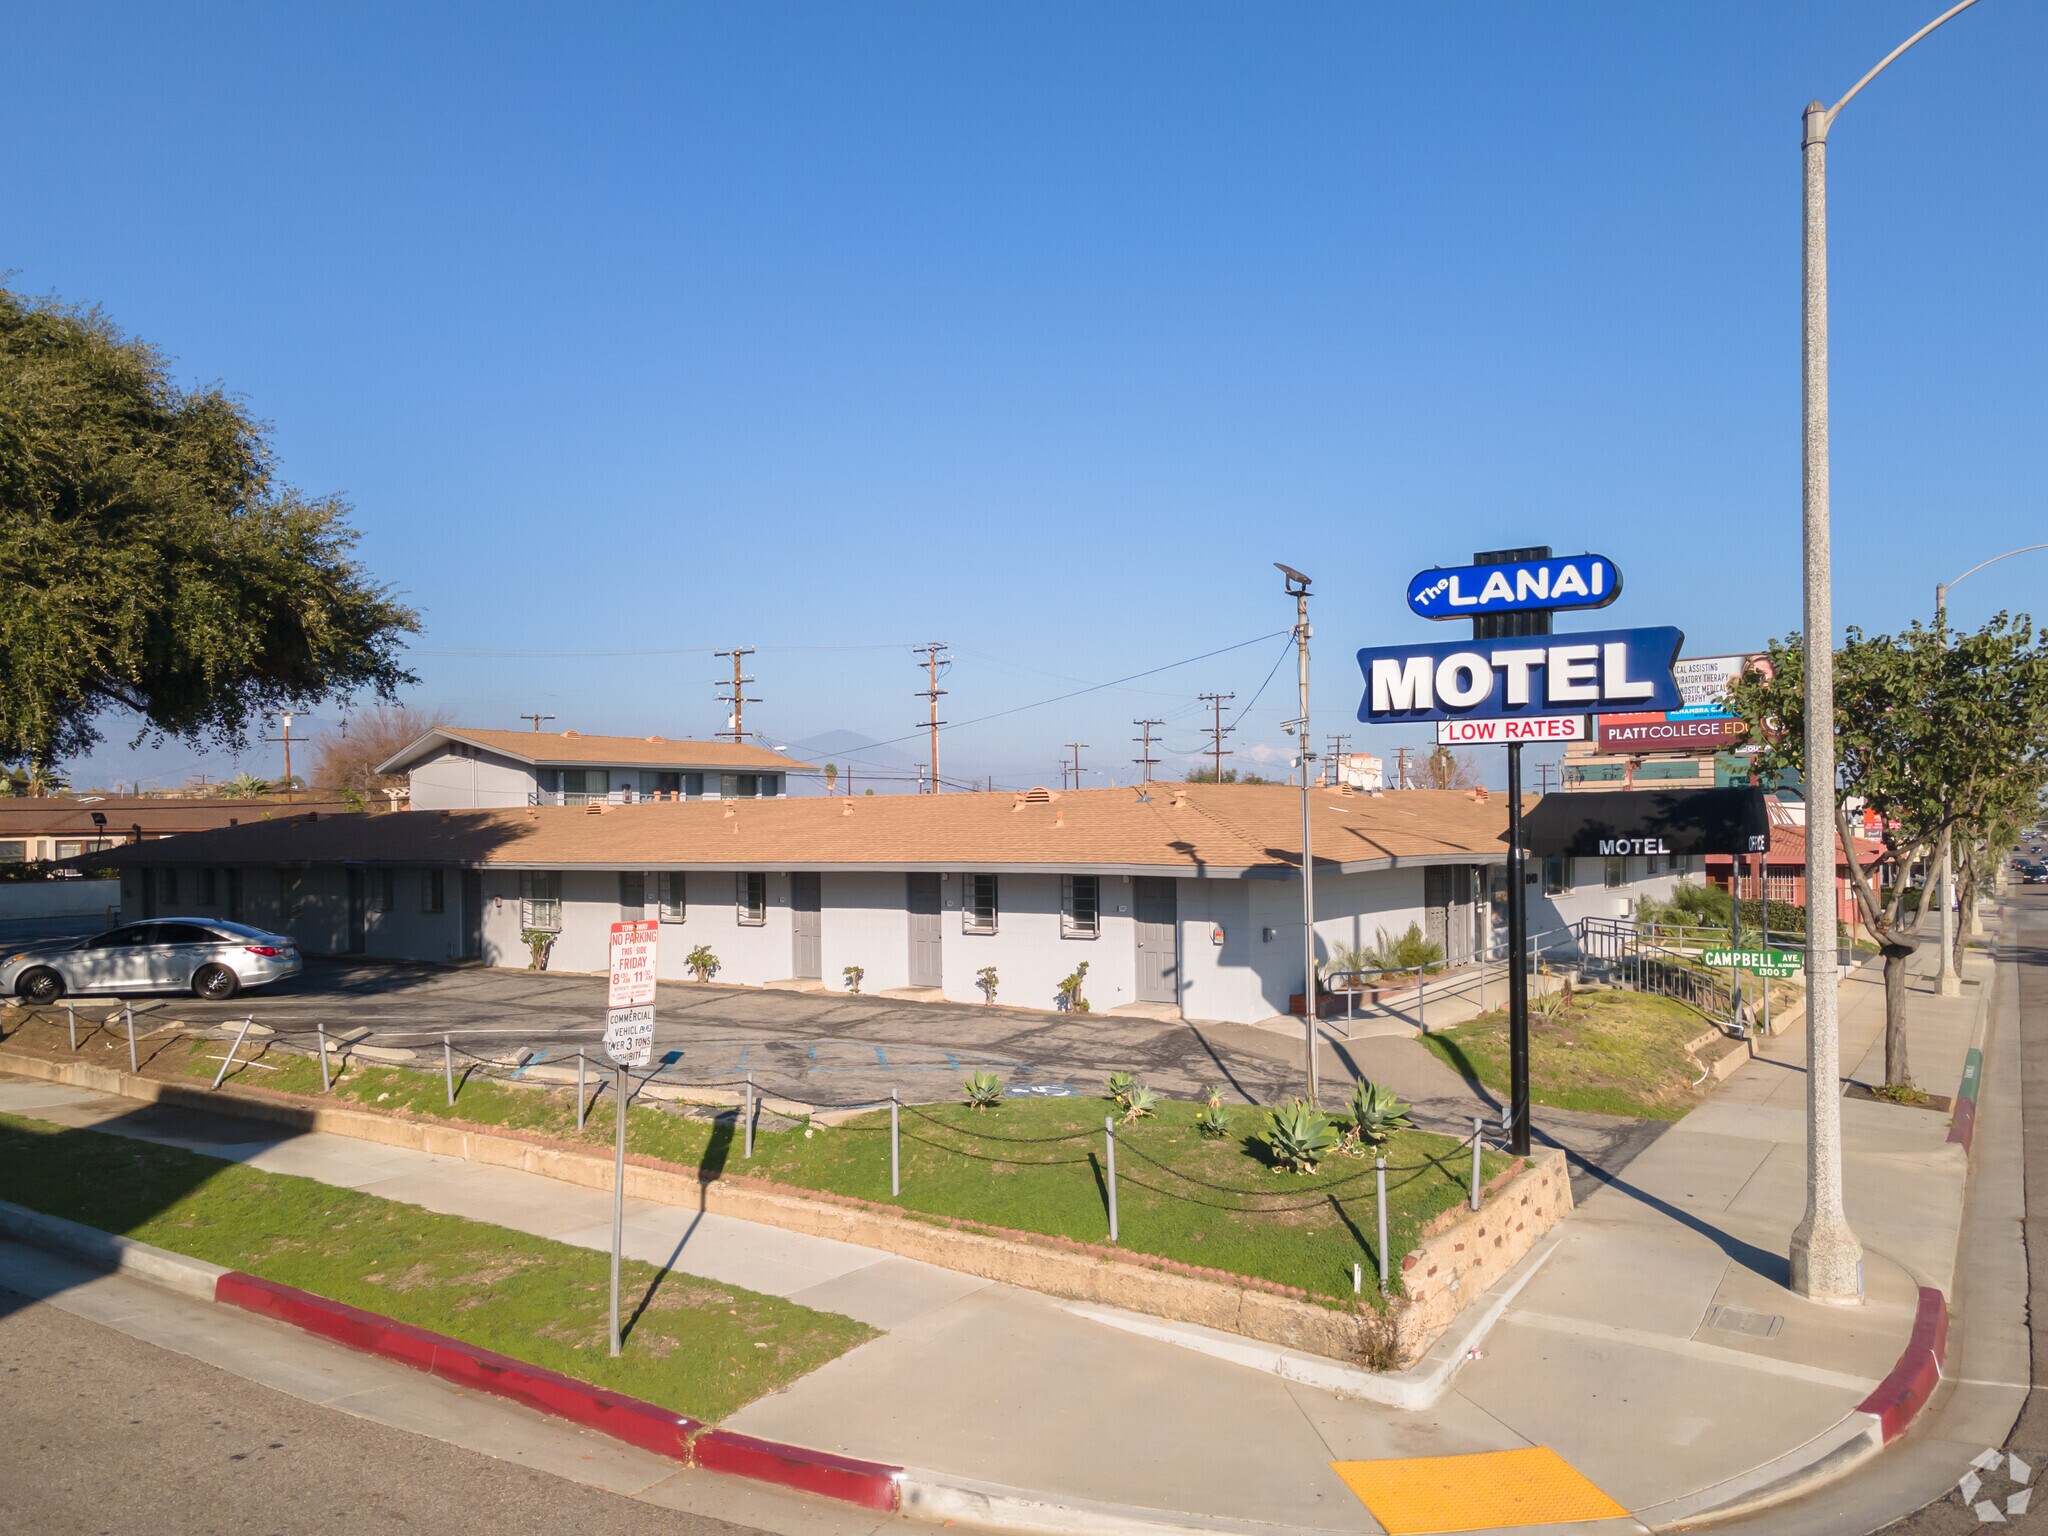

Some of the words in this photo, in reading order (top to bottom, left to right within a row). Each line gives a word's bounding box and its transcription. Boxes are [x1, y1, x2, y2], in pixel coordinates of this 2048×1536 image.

[1414, 578, 1449, 606] The
[1449, 562, 1604, 606] LANAI
[1675, 665, 1687, 674] ICAL
[1689, 662, 1719, 673] ASSISTING
[1372, 642, 1655, 711] MOTEL
[1703, 673, 1729, 683] THERAPY
[1680, 686, 1700, 695] NOSTIC
[1702, 684, 1727, 693] MEDICAL
[1684, 695, 1706, 703] GRAPHY
[1449, 723, 1496, 741] LOW
[1505, 719, 1576, 739] RATES
[1600, 838, 1670, 855] MOTEL
[1749, 835, 1765, 850] OFFICE
[612, 934, 622, 946] NO
[625, 931, 657, 945] PARKING
[622, 947, 632, 955] THIS
[636, 946, 647, 955] SIDE
[619, 956, 648, 970] FRIDAY
[1705, 952, 1775, 967] CAMPBELL
[612, 973, 620, 985] 8
[634, 971, 643, 982] 11
[1759, 968, 1779, 976] 1300
[610, 1011, 651, 1025] COMMERCIAL
[626, 1037, 632, 1050] 3
[635, 1036, 651, 1048] TONS
[613, 1051, 641, 1062] OHIBIT
